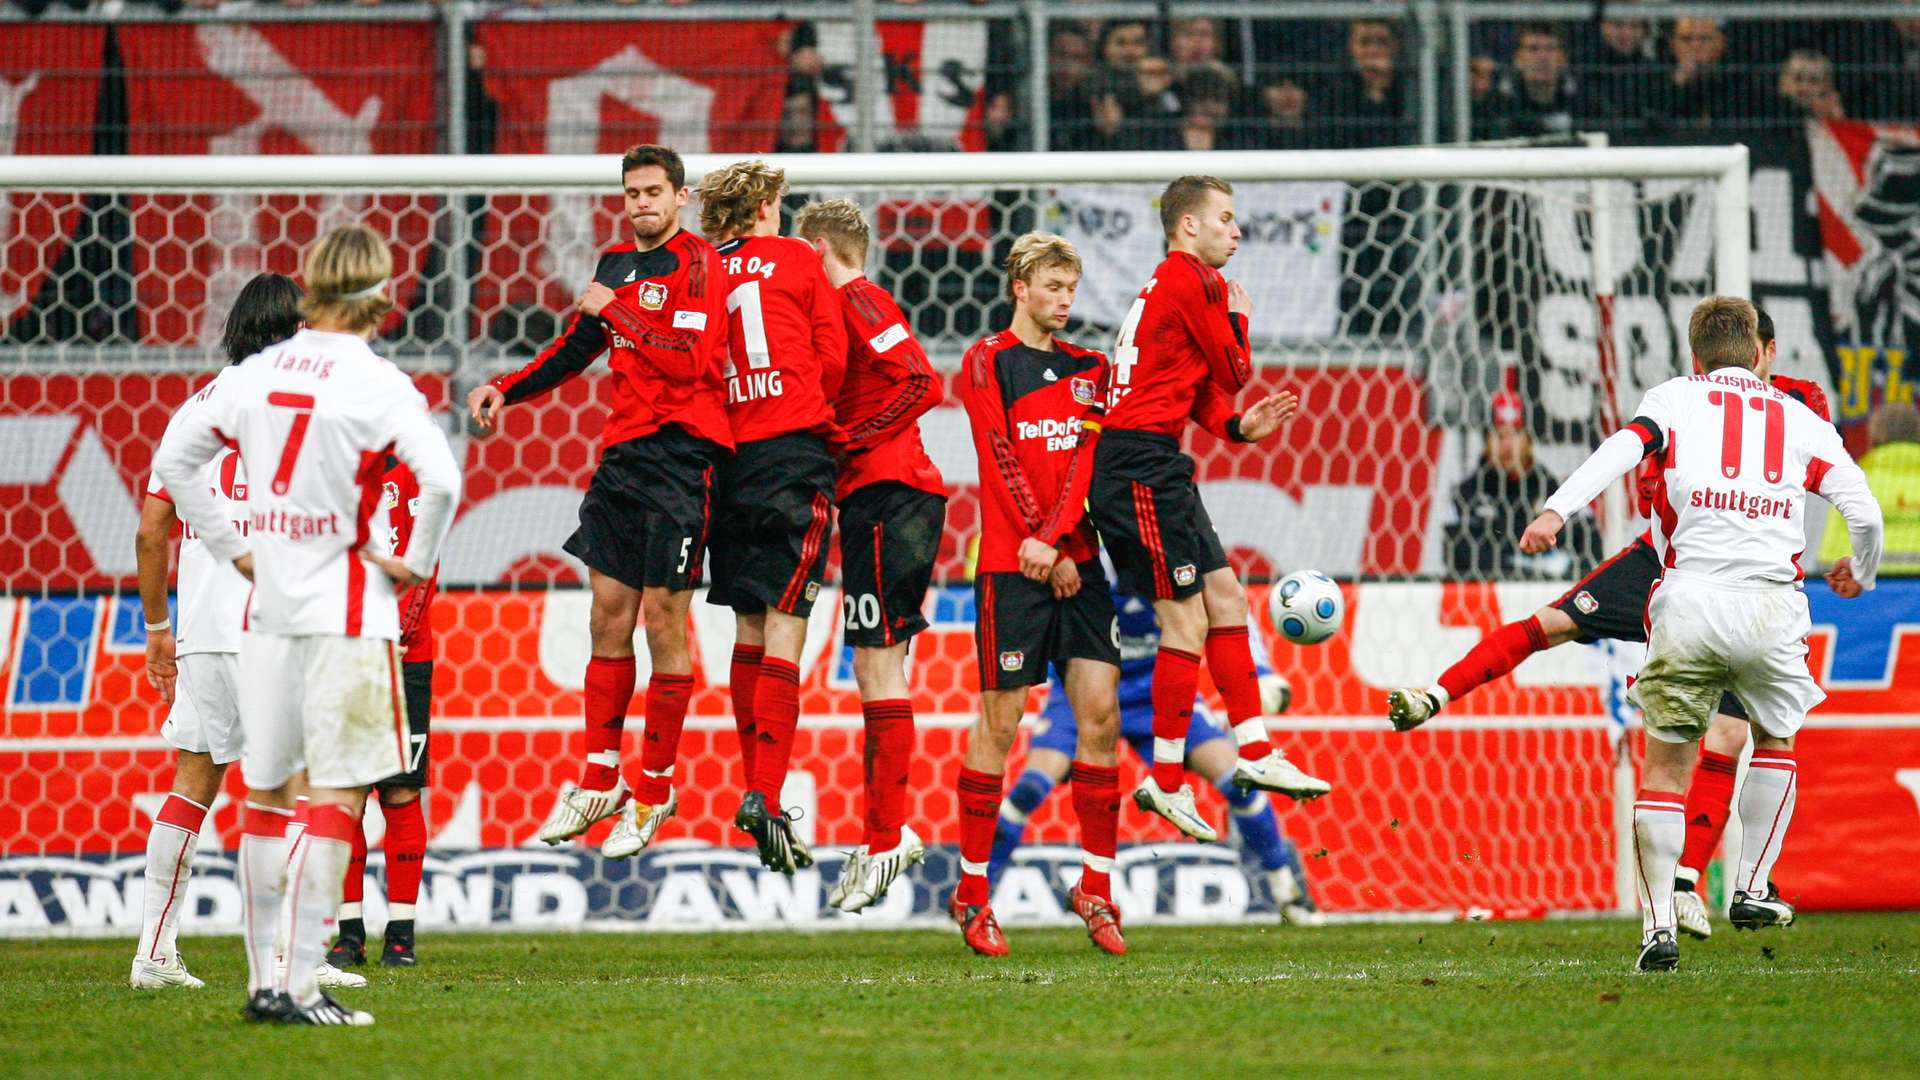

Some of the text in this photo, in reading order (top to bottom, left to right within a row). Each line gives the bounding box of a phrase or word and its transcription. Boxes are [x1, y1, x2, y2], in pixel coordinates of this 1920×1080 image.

[273, 351, 336, 380] lanig
[266, 391, 316, 496] 7
[1708, 390, 1785, 484] 11
[1690, 486, 1794, 521] stuttgart
[676, 537, 692, 574] 5
[844, 592, 881, 630] 20
